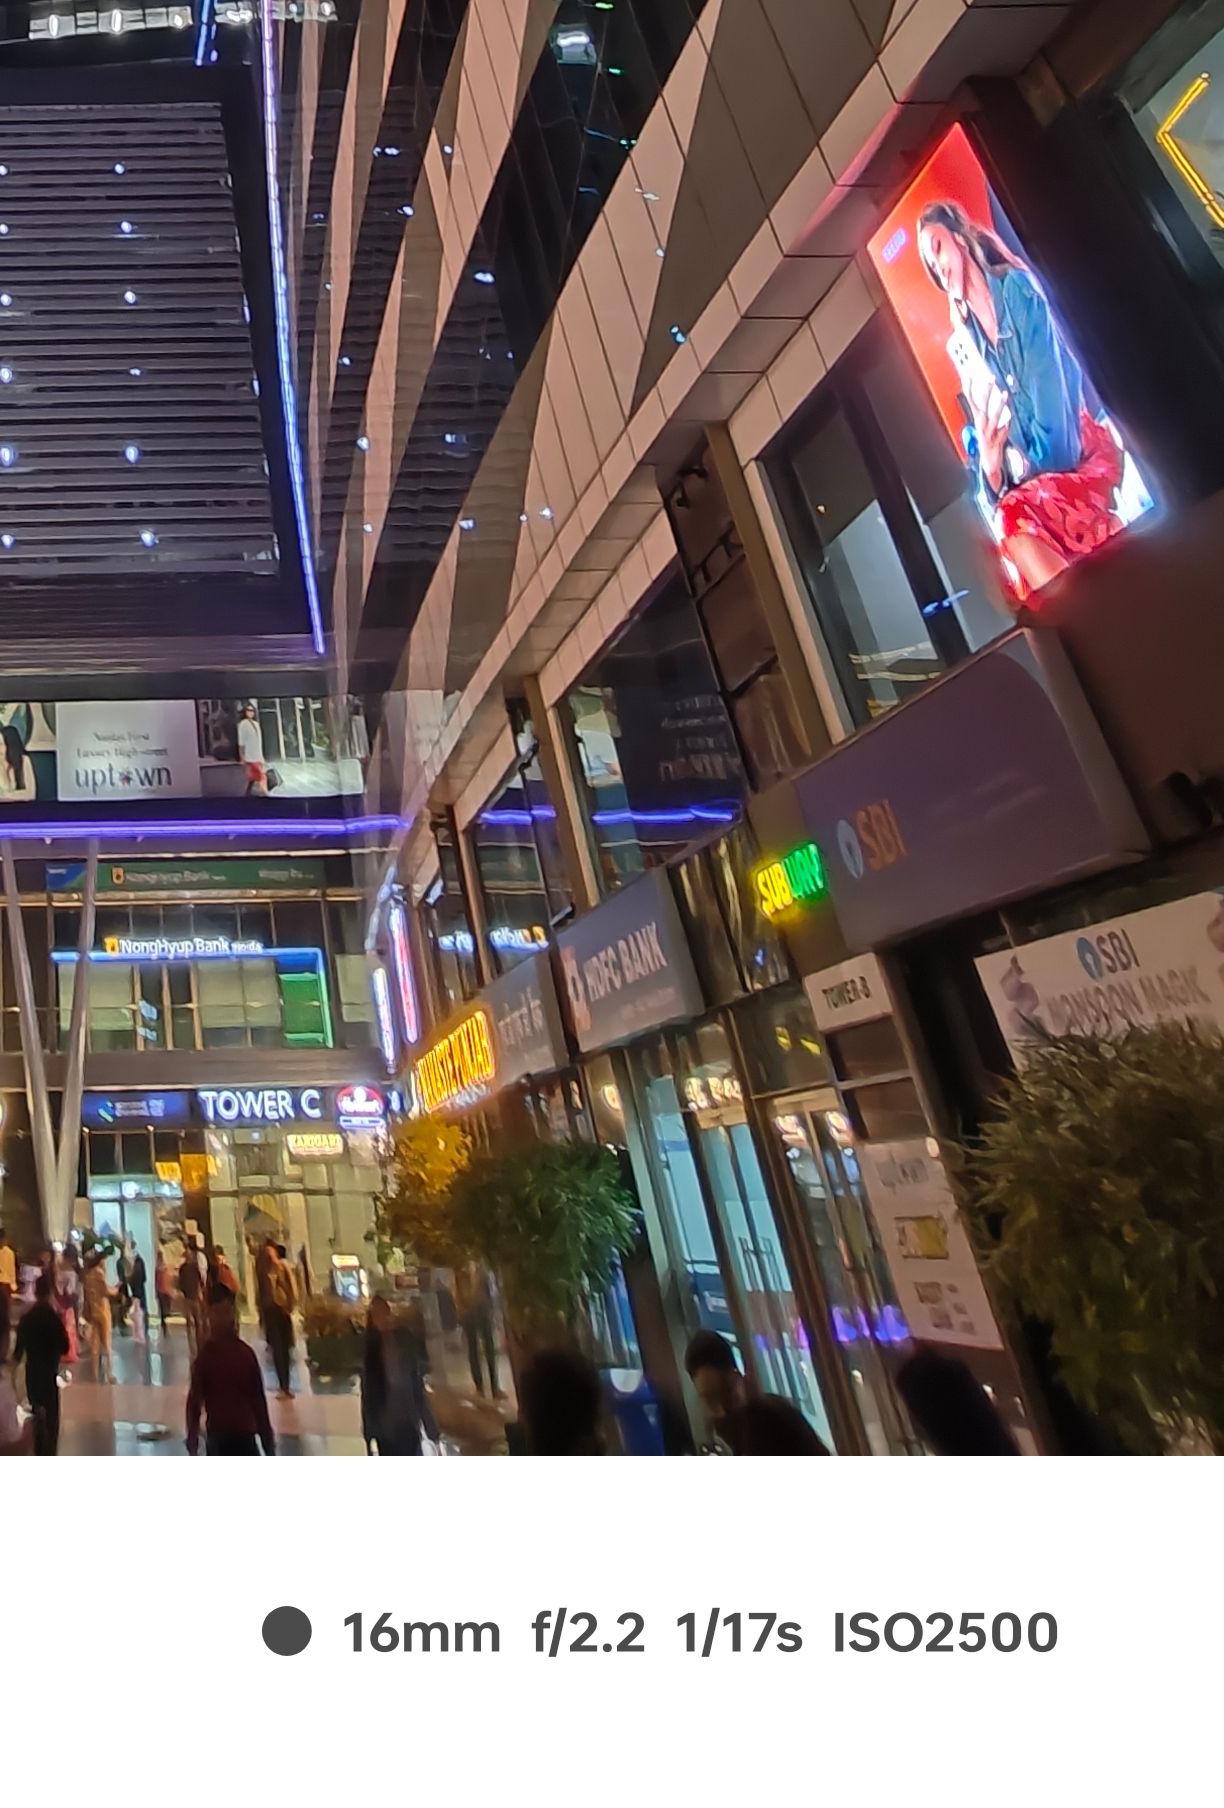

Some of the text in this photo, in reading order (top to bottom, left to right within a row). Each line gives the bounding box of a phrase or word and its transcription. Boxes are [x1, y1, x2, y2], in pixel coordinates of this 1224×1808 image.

[856, 799, 909, 871] SBI
[757, 843, 824, 917] SUBWAY
[120, 939, 194, 960] NongHyup
[194, 937, 230, 953] Bank
[618, 920, 668, 984] BANK
[1096, 928, 1140, 974] SBI
[198, 1090, 294, 1121] TOWER
[301, 1089, 322, 1119] C
